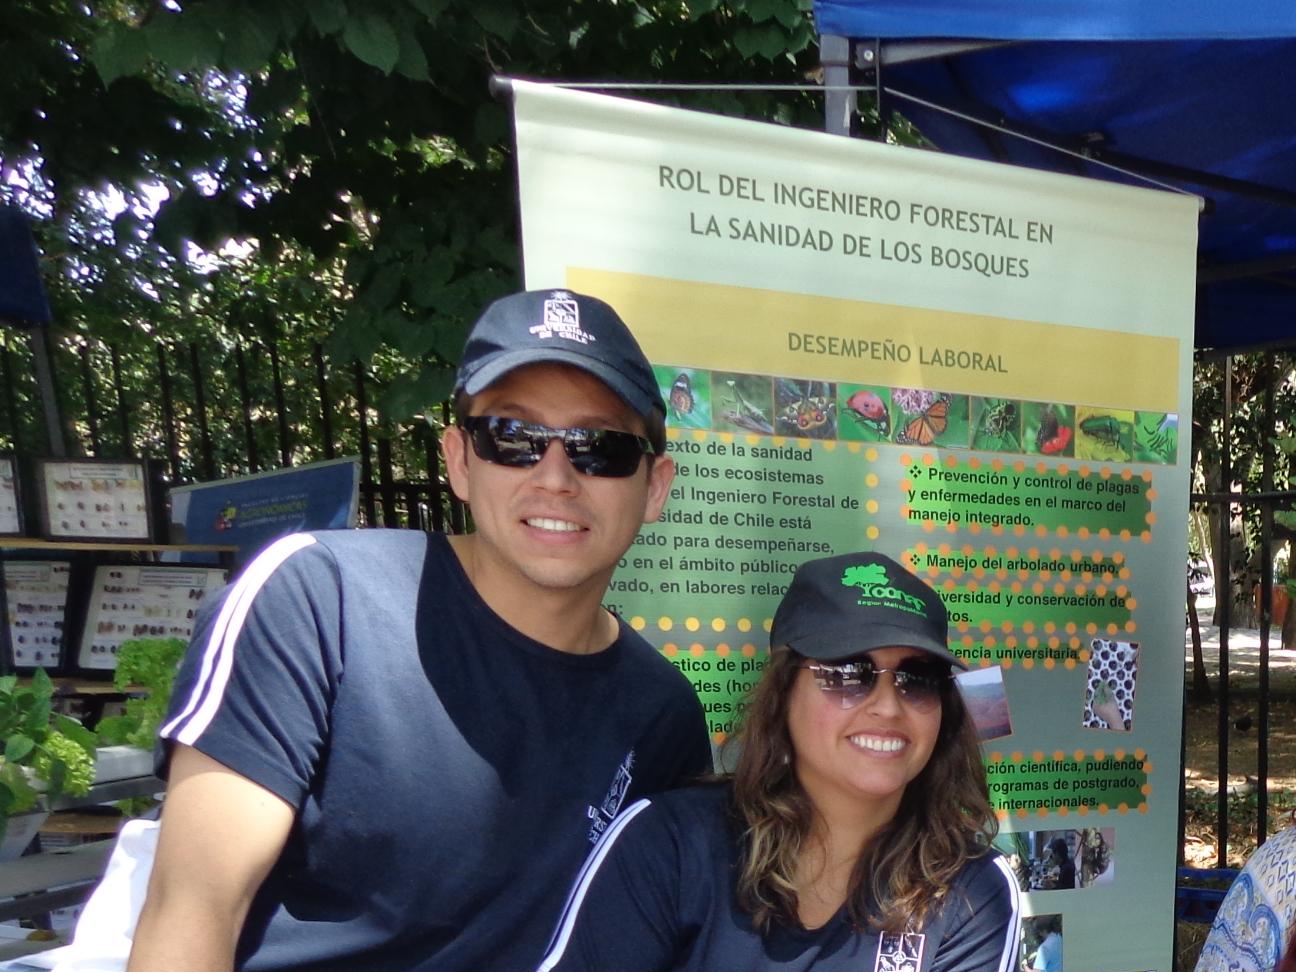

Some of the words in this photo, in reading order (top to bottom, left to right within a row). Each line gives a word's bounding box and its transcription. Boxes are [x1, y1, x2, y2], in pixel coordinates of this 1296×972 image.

[658, 164, 711, 195] ROL
[718, 173, 766, 204] DEL
[772, 181, 903, 223] INGENIERO
[909, 203, 1020, 241] FORESTAL
[1026, 220, 1055, 246] EN
[689, 211, 723, 239] LA
[727, 217, 835, 254] SANIDAD
[842, 233, 872, 259] DE
[879, 237, 924, 265] LOS
[930, 245, 1031, 279] BOSQUES
[787, 331, 912, 364] DESEMPEÑO
[917, 346, 1009, 374] LABORAL
[665, 440, 701, 455] exto
[706, 441, 728, 456] de
[731, 442, 746, 457] la
[750, 446, 813, 462] sanidad
[695, 463, 720, 479] los
[724, 469, 825, 486] ecosistemas
[928, 467, 1009, 486] Prevención
[1012, 474, 1020, 488] y
[1024, 474, 1073, 490] control
[1076, 477, 1092, 492] de
[1096, 479, 1140, 496] plagas
[670, 485, 685, 500] el
[690, 486, 767, 506] Ingeniero
[772, 491, 836, 509] Forestal
[840, 495, 860, 510] de
[907, 488, 916, 502] y
[920, 487, 1021, 506] enfermedades
[1024, 496, 1042, 508] en
[1045, 495, 1058, 509] el
[1061, 498, 1103, 511] marco
[1106, 497, 1127, 513] del
[658, 509, 704, 525] sidad
[708, 510, 729, 525] de
[733, 512, 775, 529] Chile
[779, 515, 813, 531] está
[907, 507, 962, 525] manejo
[965, 507, 1036, 527] integrado.
[673, 532, 710, 551] para
[714, 534, 835, 555] desempeñarse,
[633, 557, 653, 570] en
[659, 555, 674, 571] el
[679, 556, 736, 573] ámbito
[926, 553, 978, 571] Manejo
[982, 555, 1003, 570] del
[1006, 557, 1067, 573] arbolado
[1069, 559, 1120, 575] urbano.
[660, 579, 681, 593] en
[685, 580, 746, 596] labores
[1005, 593, 1013, 606] y
[1017, 592, 1106, 608] conservación
[1109, 592, 1126, 608] de
[995, 646, 1081, 662] universitaria.
[716, 658, 737, 673] de
[1020, 760, 1082, 775] científica,
[1086, 758, 1145, 775] pudiendo
[988, 779, 1049, 797] rogramas
[1053, 779, 1070, 791] de
[998, 796, 1100, 811] internacionales.
